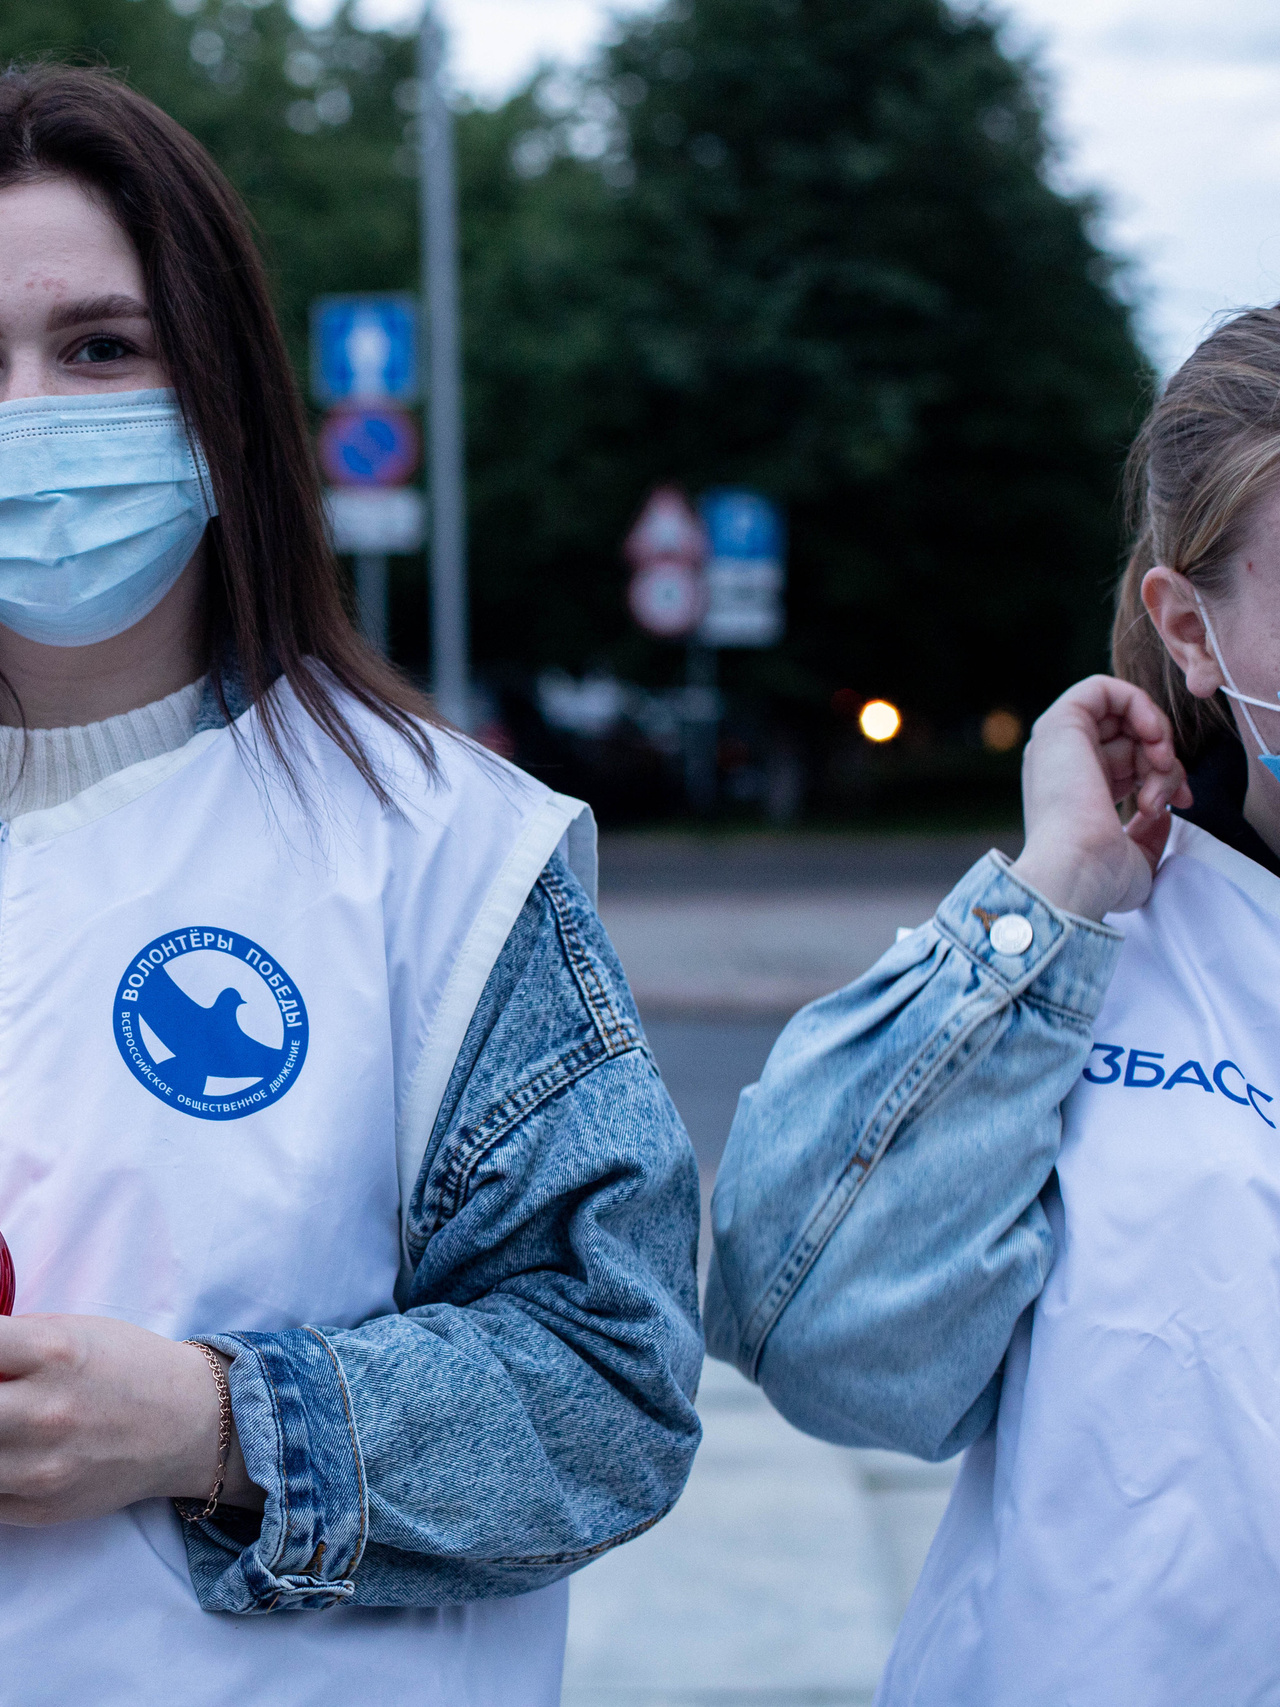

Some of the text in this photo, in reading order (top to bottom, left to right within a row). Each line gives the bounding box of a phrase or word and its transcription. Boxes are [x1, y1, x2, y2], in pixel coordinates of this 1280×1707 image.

[121, 929, 303, 1028] ВОЛОНТЁРЫ ПОБЕДЫ
[121, 1011, 301, 1113] ВСЕРОССИЙСКОЕ ОБЩЕСТВЕННОЕ ДВИЖЕНИЕ
